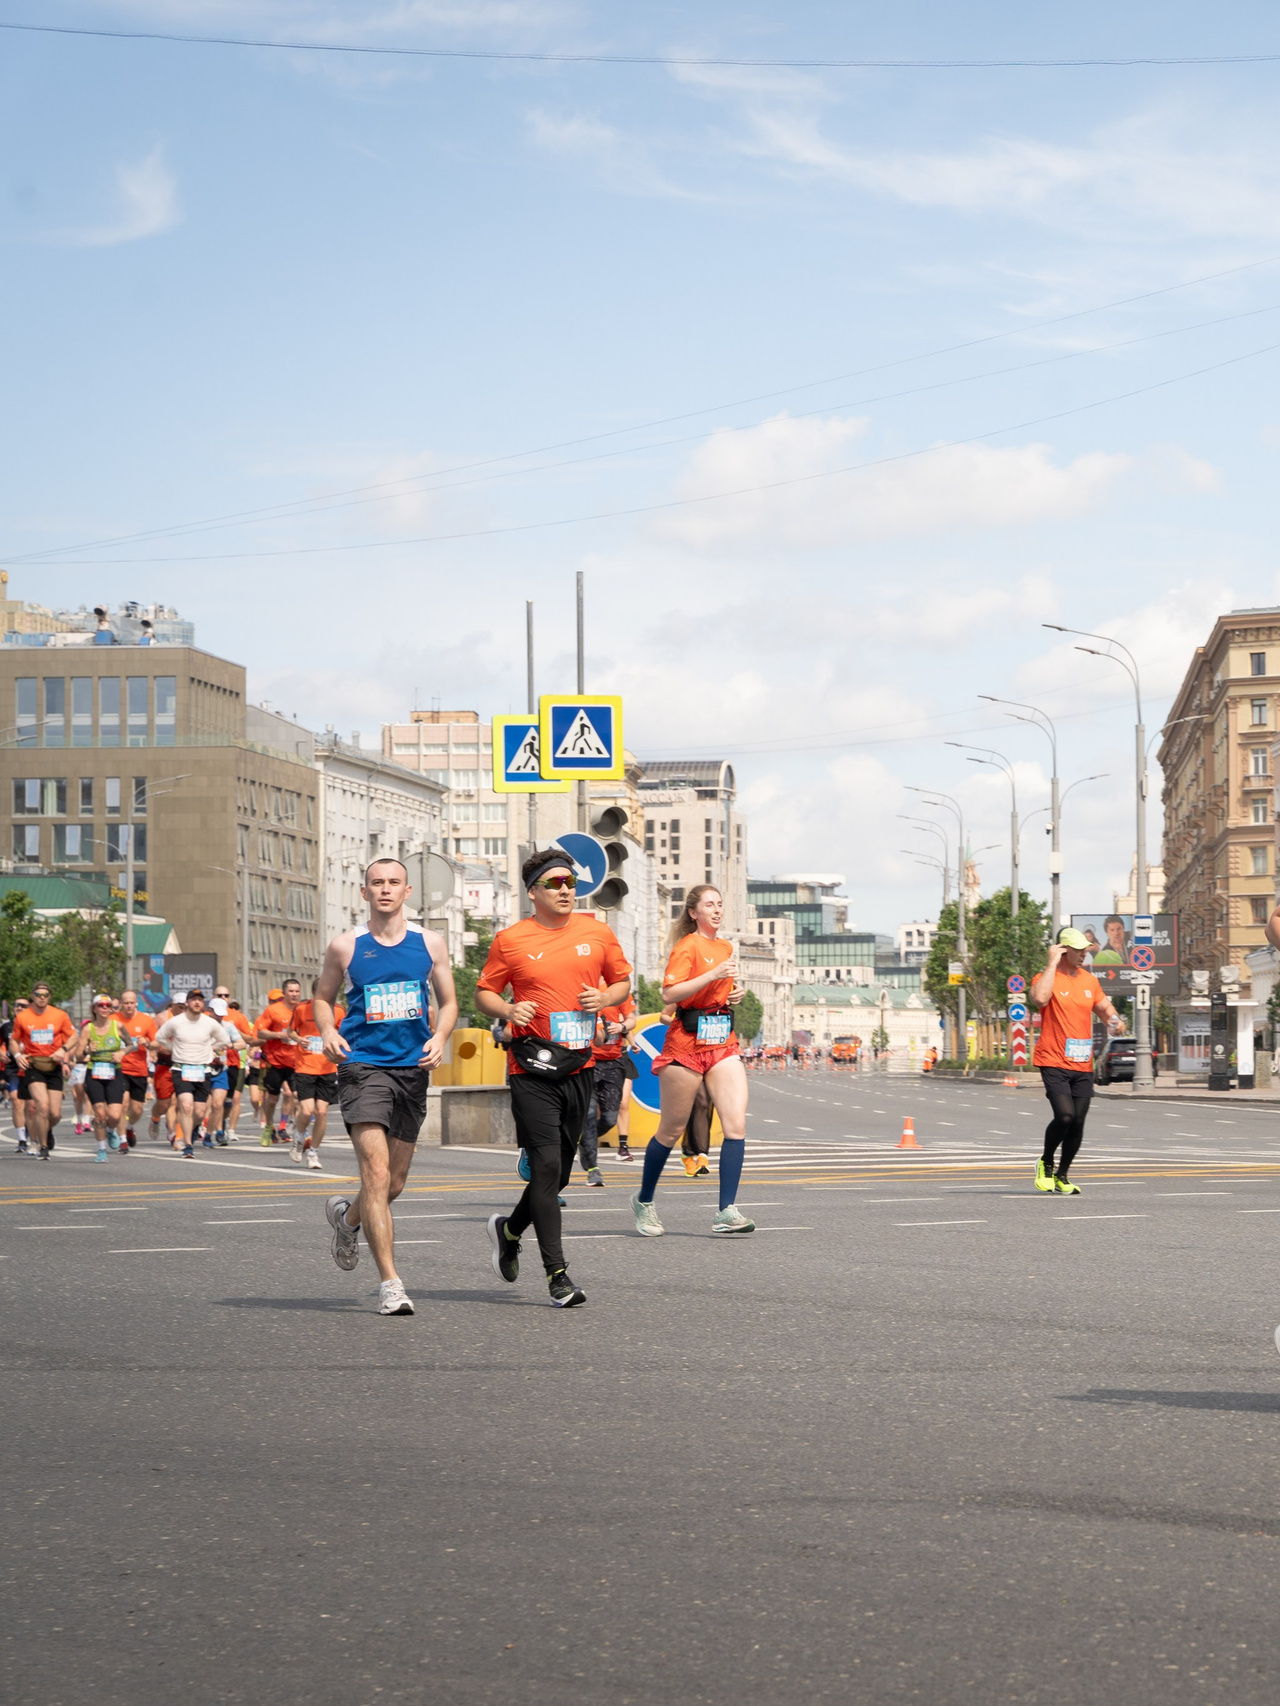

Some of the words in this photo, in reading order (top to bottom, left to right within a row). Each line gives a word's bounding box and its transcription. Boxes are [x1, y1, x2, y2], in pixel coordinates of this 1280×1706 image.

[169, 974, 213, 988] НЕДЕЛЮ
[370, 991, 417, 1014] 91389
[408, 1008, 417, 1018] D
[558, 1020, 592, 1040] 75118
[701, 1023, 727, 1039] 71053
